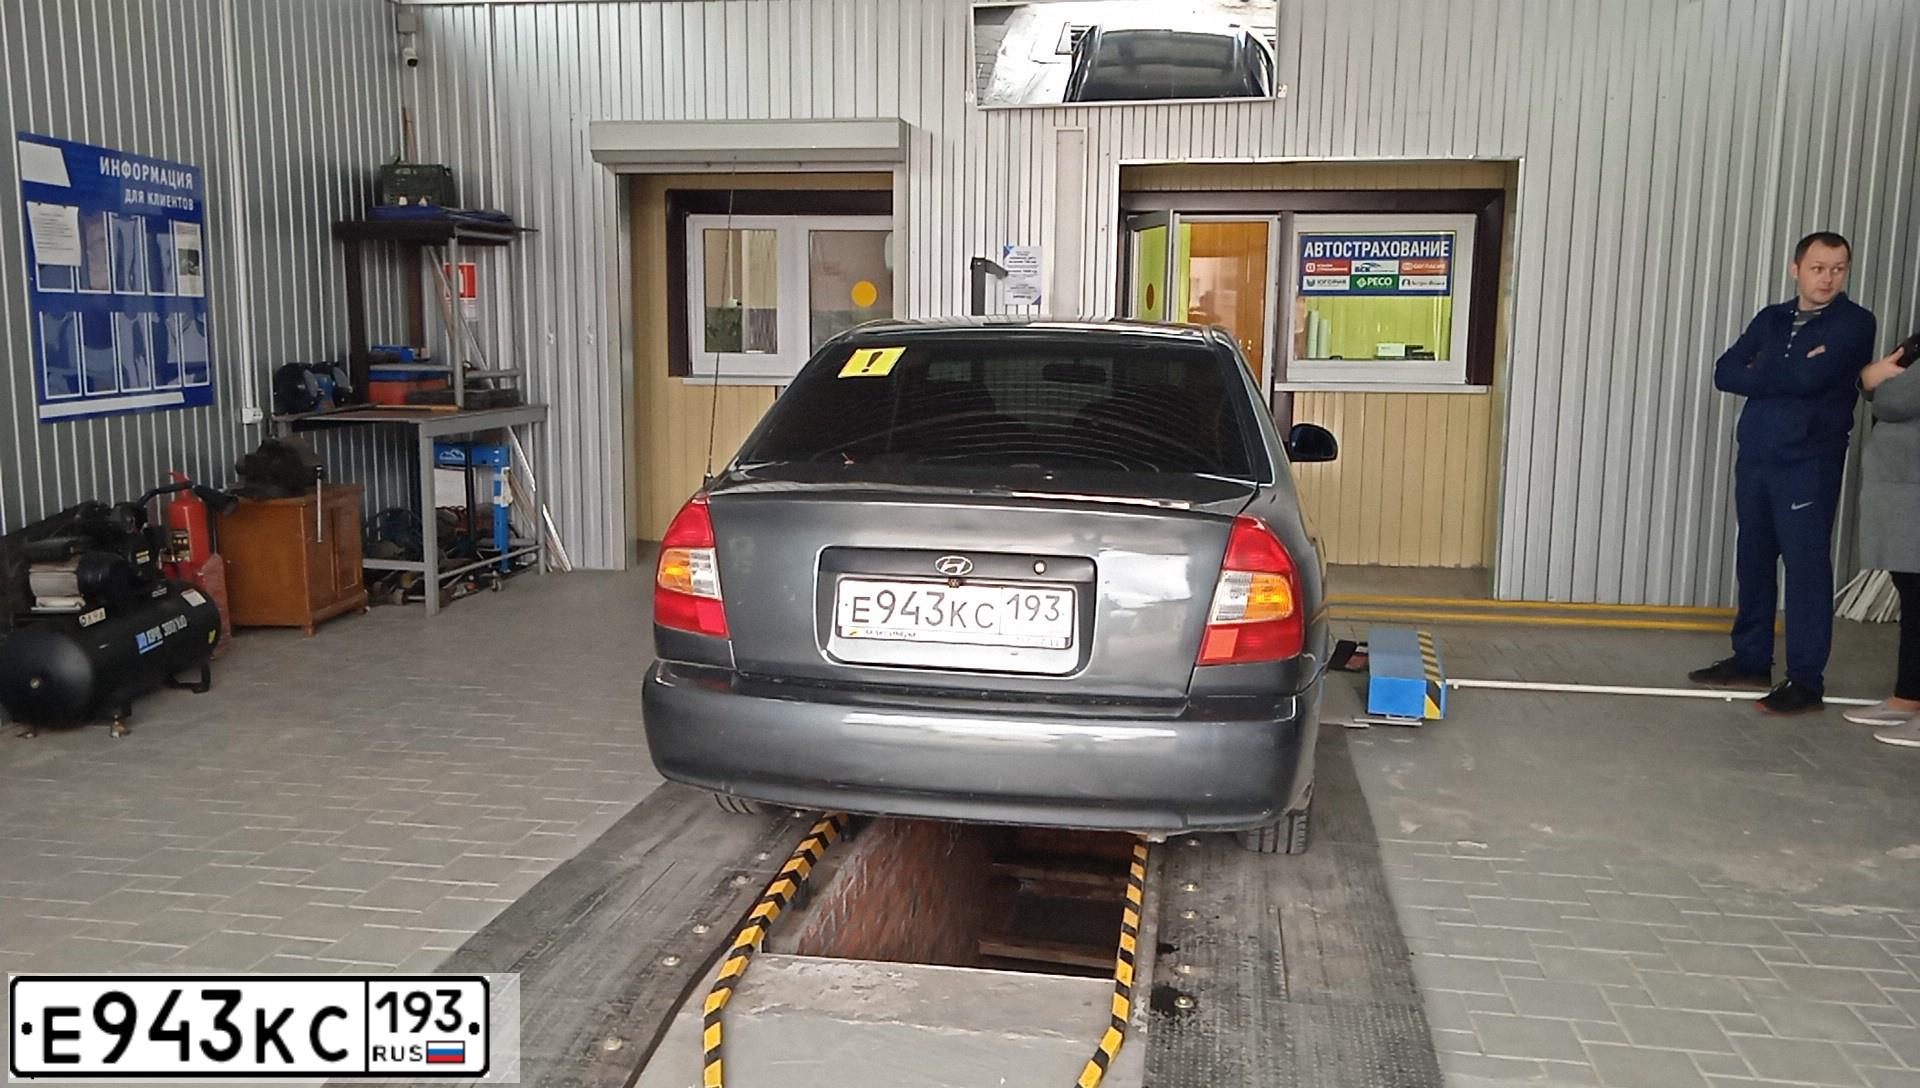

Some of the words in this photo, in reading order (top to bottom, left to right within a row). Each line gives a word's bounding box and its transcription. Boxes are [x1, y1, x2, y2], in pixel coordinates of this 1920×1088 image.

[99, 156, 193, 189] ИНФОРМАЦИЯ
[124, 188, 145, 204] ДЛЯ
[147, 192, 194, 211] КЛИЕНТОВ
[1304, 241, 1449, 258] АВТОСТРАХОВАНИЕ
[1367, 277, 1392, 286] РЕСО
[852, 590, 995, 628] Е943КС
[1006, 594, 1060, 621] 193
